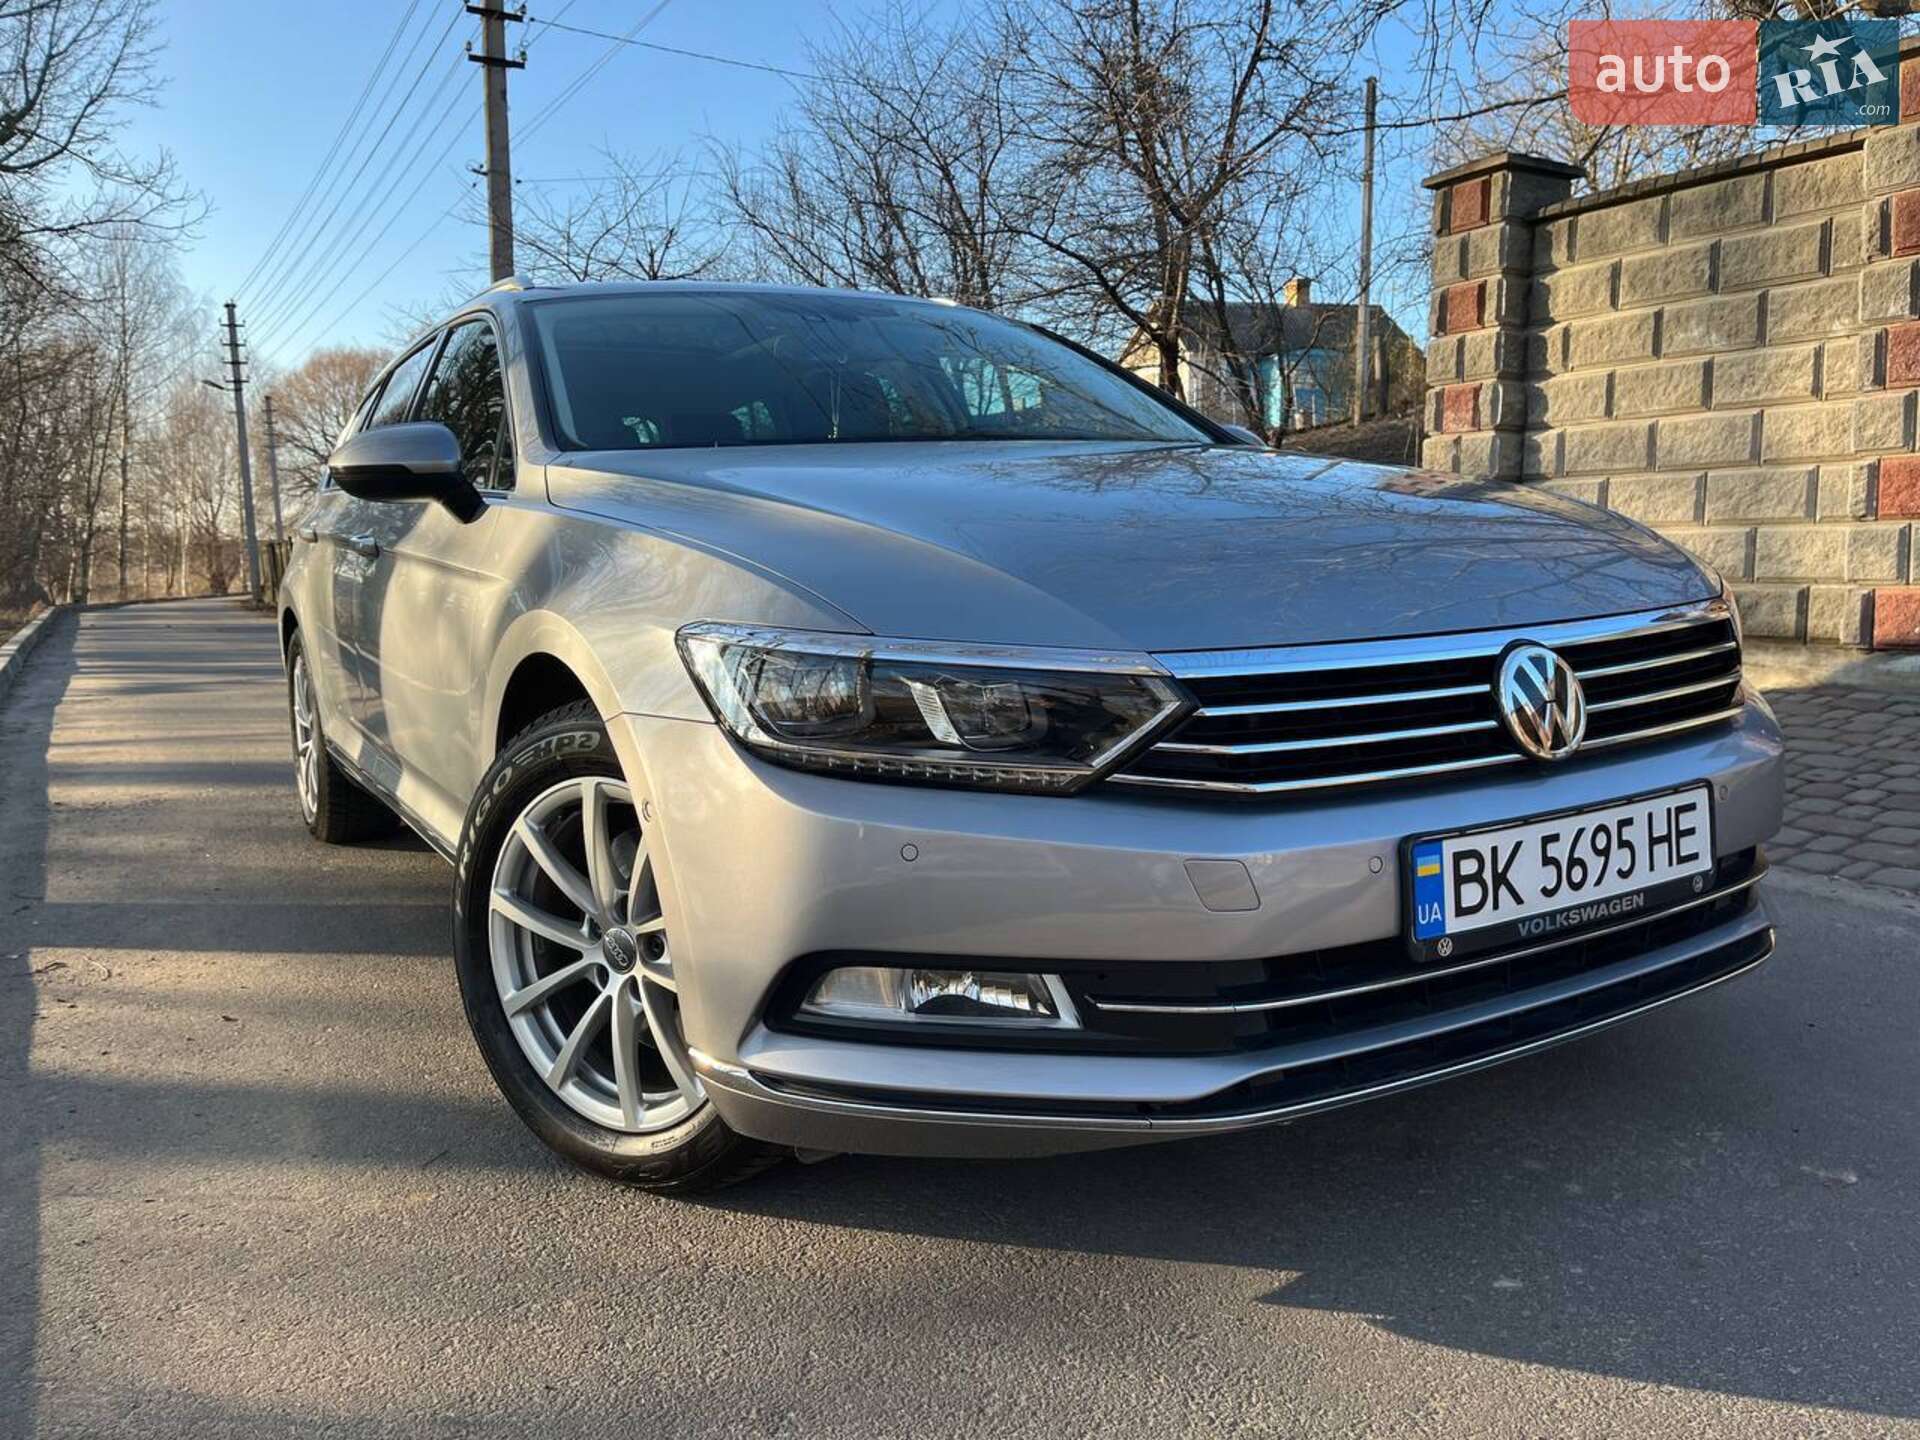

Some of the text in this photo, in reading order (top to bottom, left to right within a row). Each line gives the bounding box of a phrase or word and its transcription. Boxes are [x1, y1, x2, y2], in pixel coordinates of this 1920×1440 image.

[1452, 801, 1700, 918] BK 5695 HE
[1418, 901, 1443, 925] UA
[1518, 894, 1645, 937] VOLKSWAGEN
